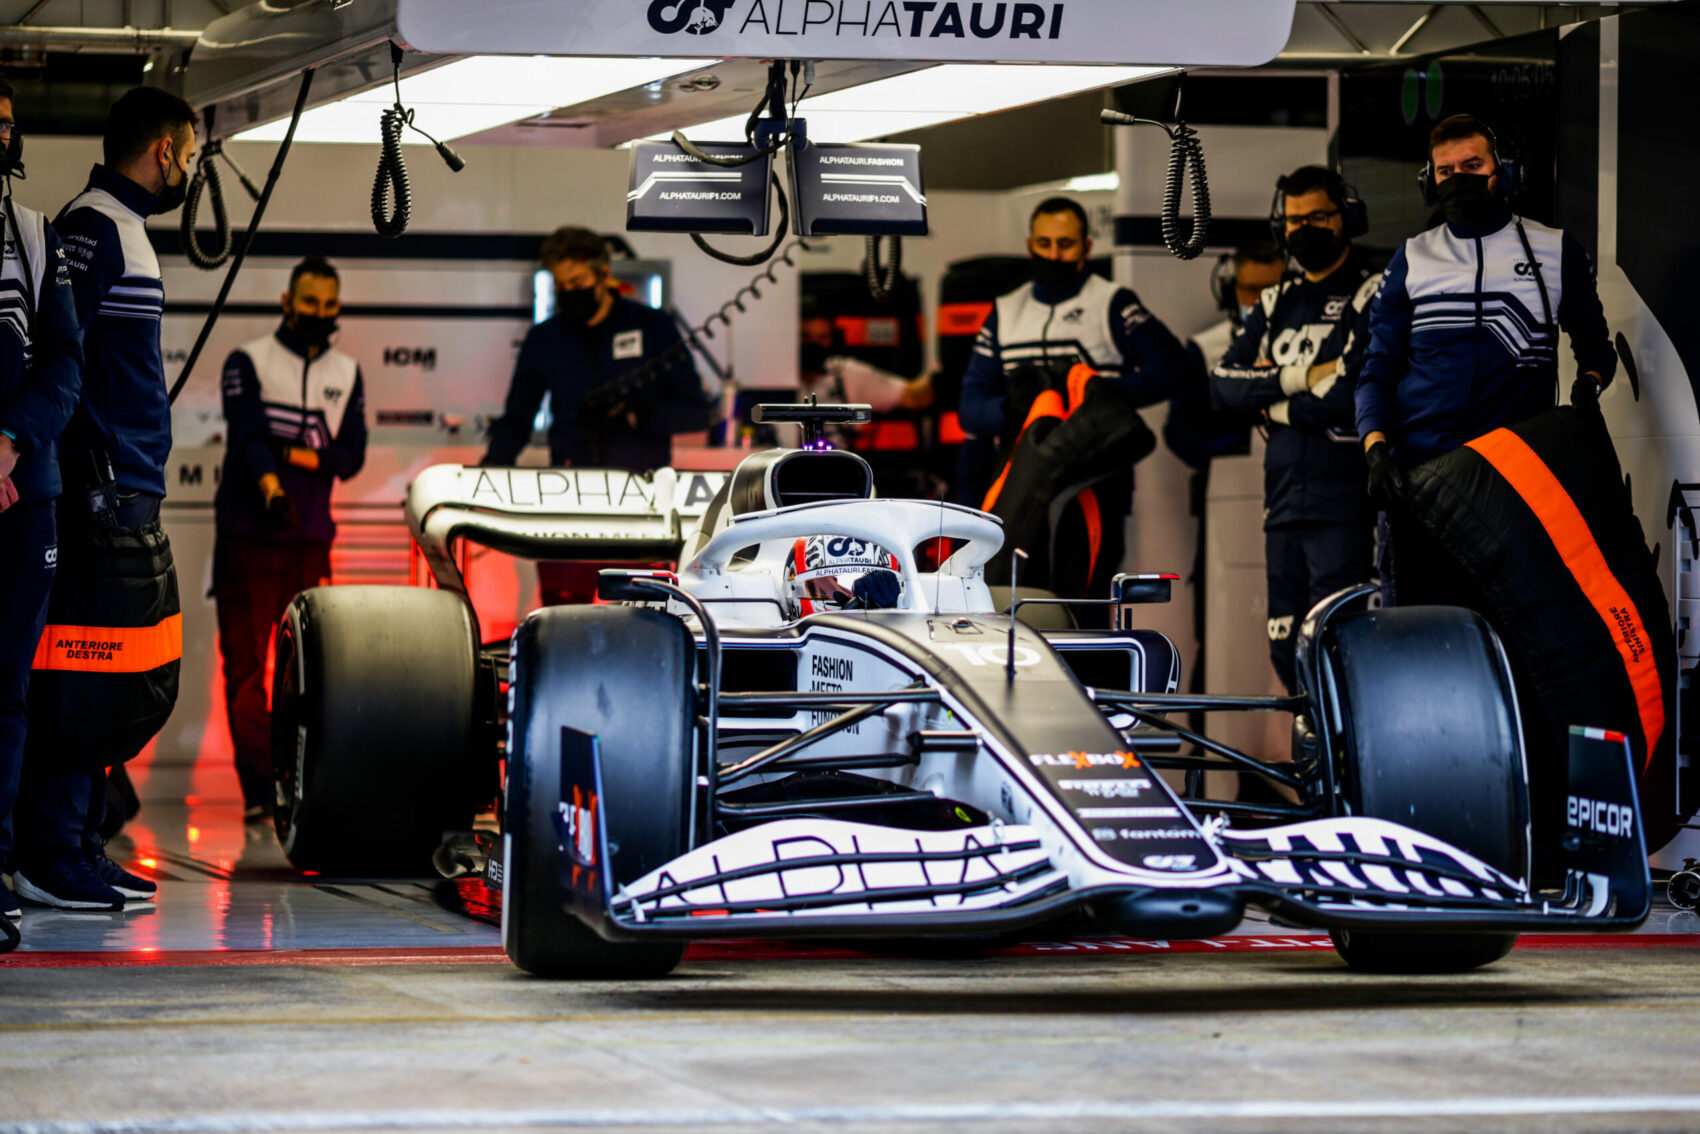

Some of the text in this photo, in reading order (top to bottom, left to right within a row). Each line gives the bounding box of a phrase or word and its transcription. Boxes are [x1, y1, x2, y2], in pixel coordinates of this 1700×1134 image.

[739, 0, 1064, 40] ALPHATAURI
[819, 156, 904, 167] ALPHATAURI.FASHION
[659, 191, 742, 200] ALPHATAURIF1.COM
[822, 193, 900, 203] ALPHATAURIF1.COM
[828, 557, 872, 565] ALPHATAURI
[1609, 606, 1640, 663] ANTERIORE
[1620, 607, 1645, 655] SINISTRA
[55, 639, 124, 652] ANTERIORE
[66, 650, 113, 661] DESTRA
[944, 645, 1042, 668] 10
[811, 654, 854, 682] FASHION
[1028, 750, 1141, 770] FLEXBOX
